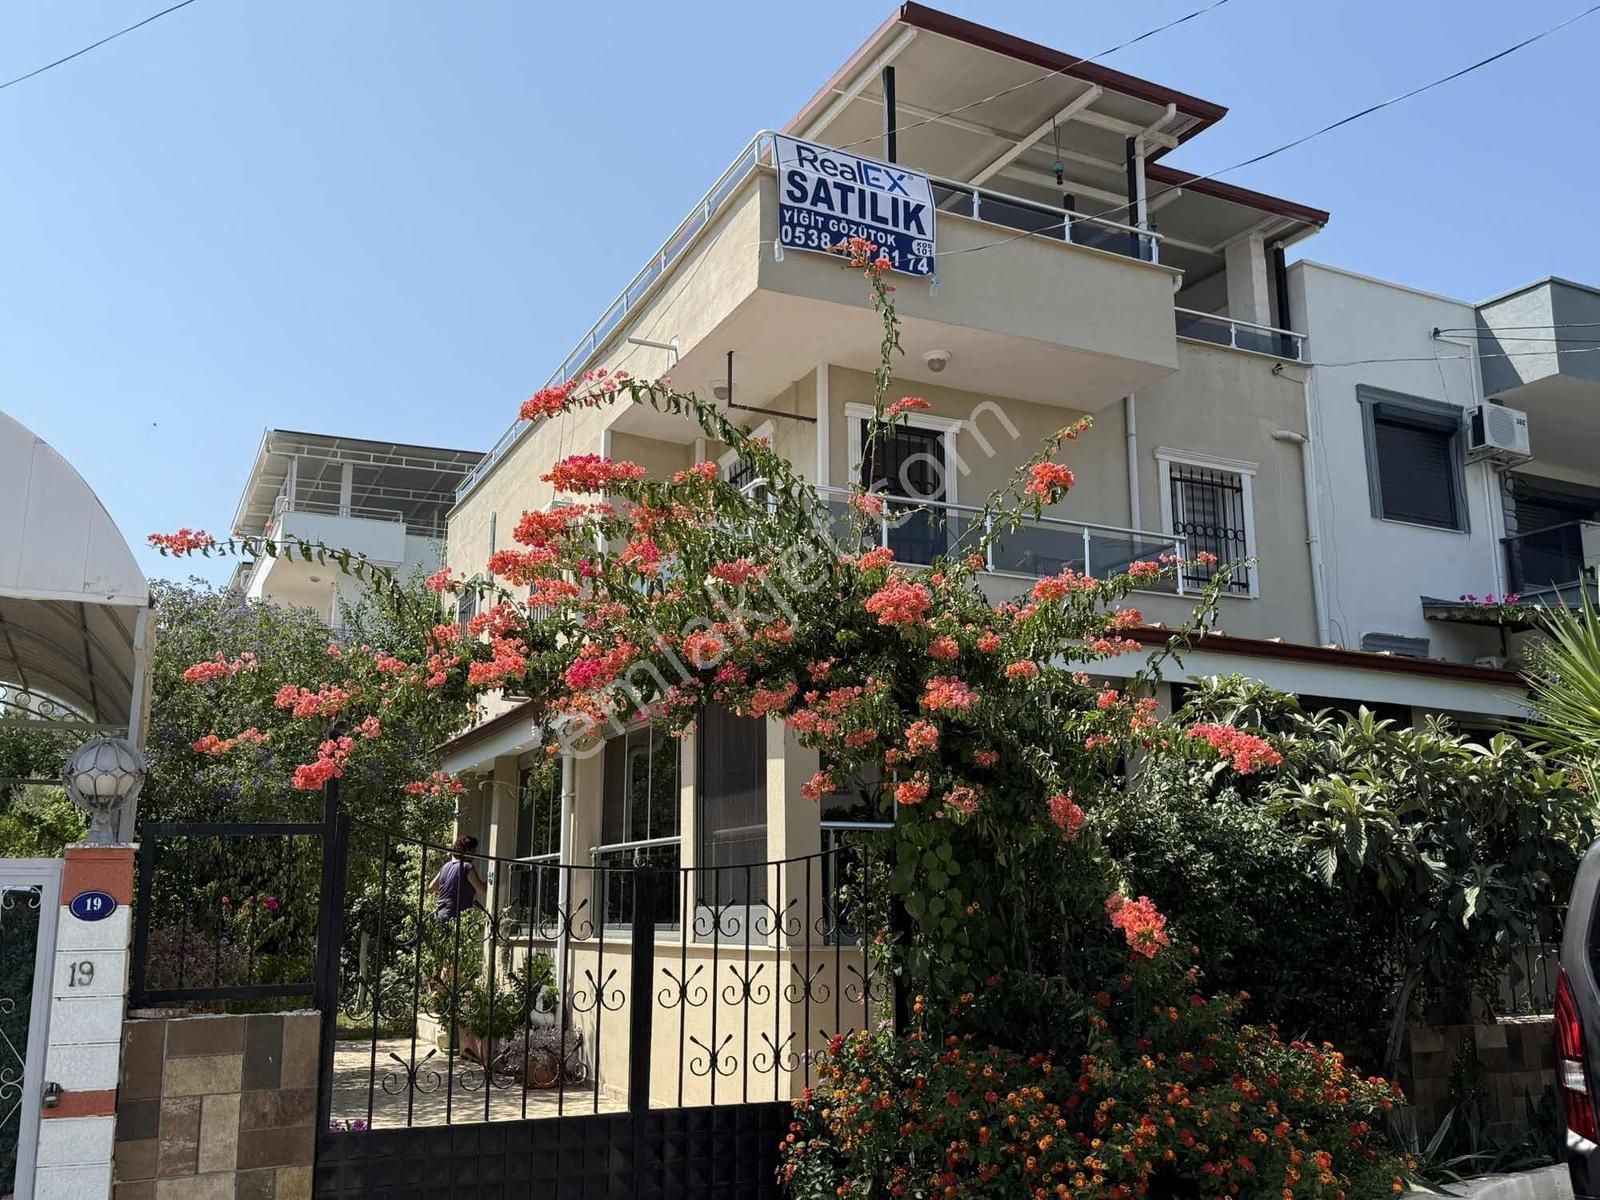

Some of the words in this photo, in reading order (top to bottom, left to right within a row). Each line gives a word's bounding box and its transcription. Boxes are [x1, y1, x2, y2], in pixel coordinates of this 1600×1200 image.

[786, 170, 927, 236] SATILIK
[783, 209, 824, 229] YİĞİT
[828, 219, 897, 247] GÖZÜTOK
[781, 225, 831, 250] 0538
[907, 253, 929, 274] 74
[85, 897, 102, 912] 19
[69, 961, 95, 988] 19
